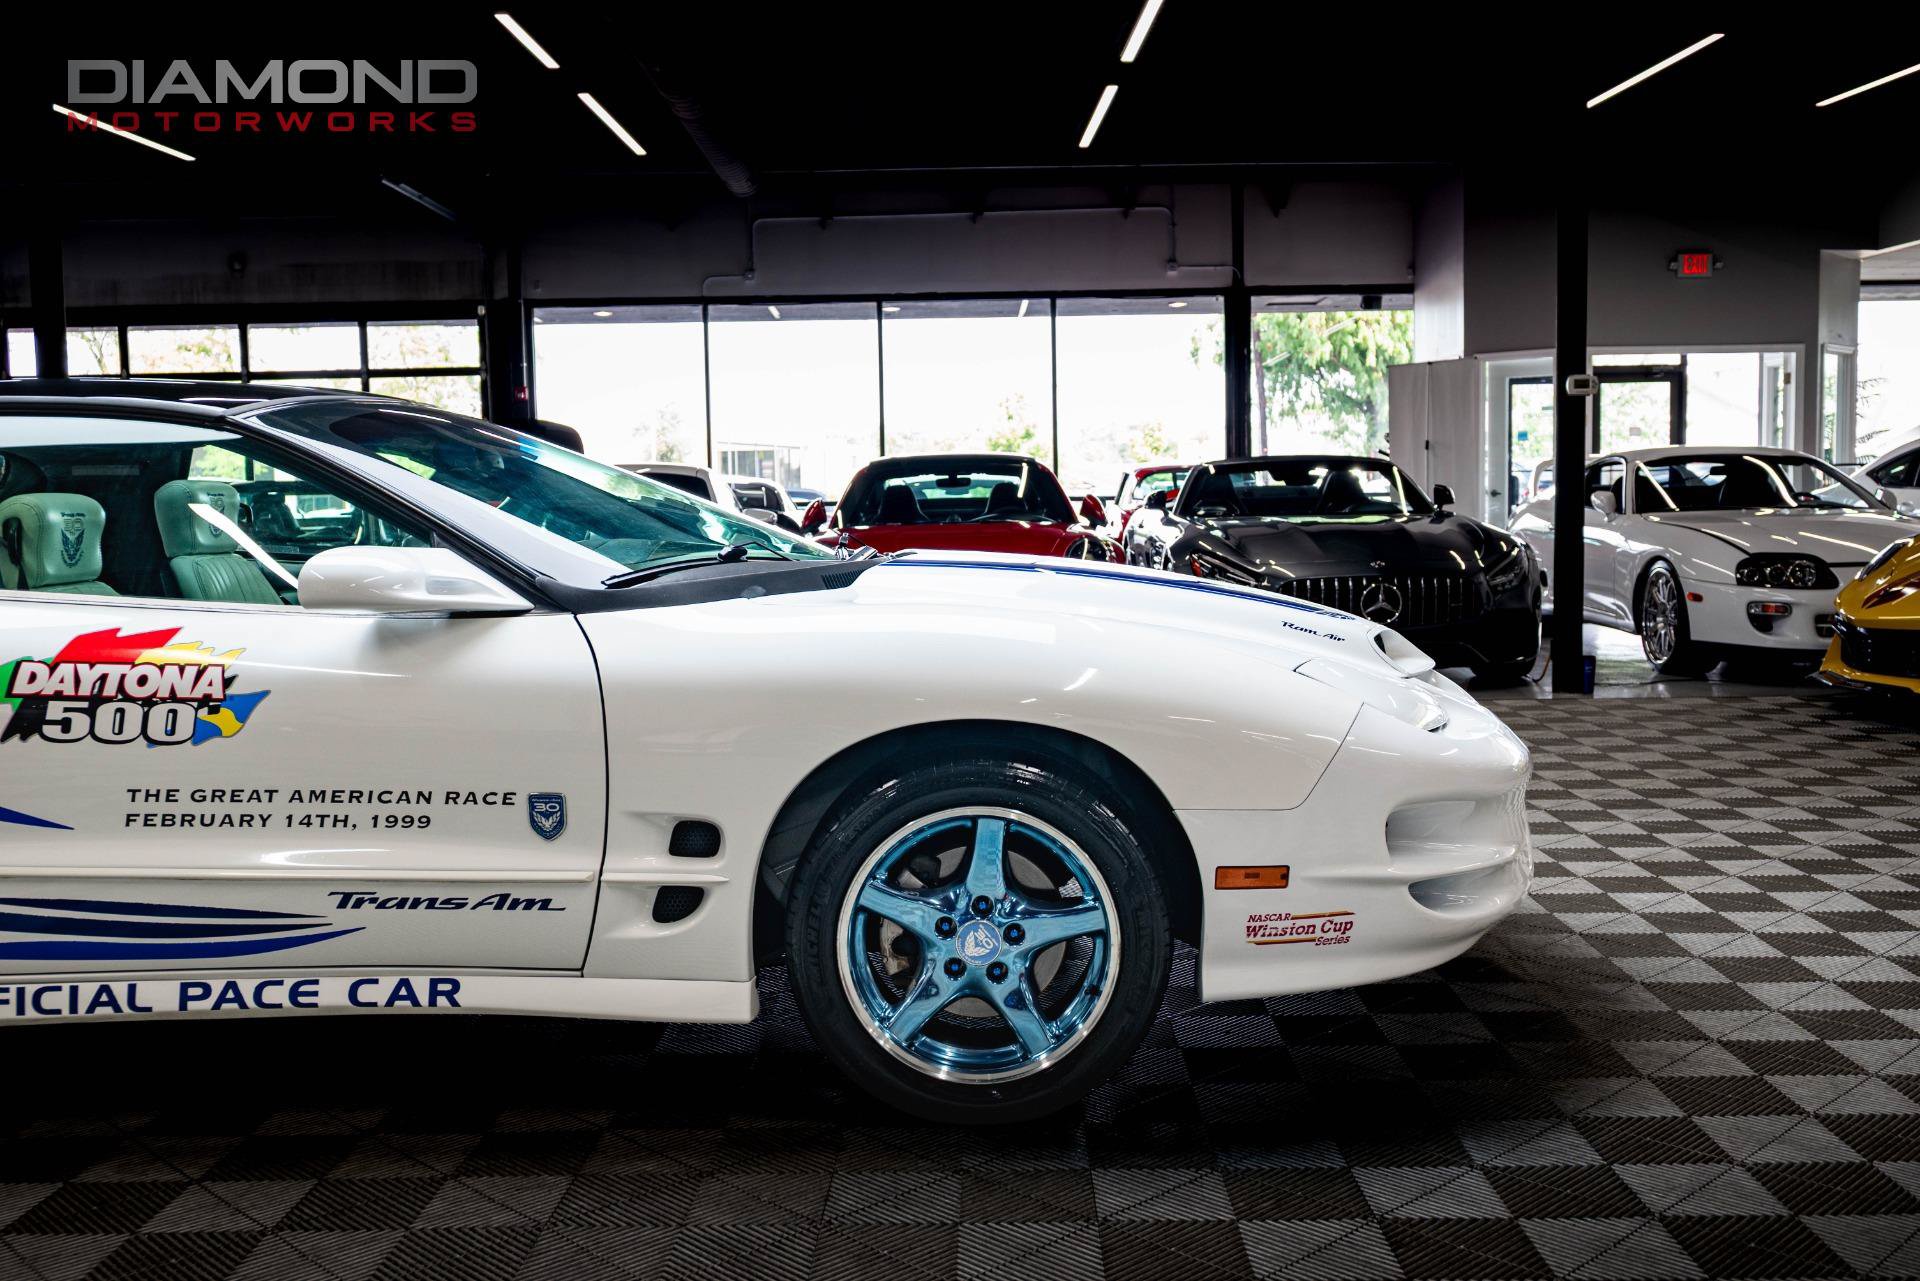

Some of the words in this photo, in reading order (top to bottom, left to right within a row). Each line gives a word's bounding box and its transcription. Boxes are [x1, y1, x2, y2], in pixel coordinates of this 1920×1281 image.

[1281, 620, 1321, 637] Ram
[1322, 633, 1346, 642] Air
[10, 660, 227, 700] DAYTONA
[40, 699, 197, 744] 500
[126, 788, 180, 803] THE
[190, 788, 279, 804] GREAT
[288, 789, 433, 805] AMERICAN
[444, 791, 517, 806] RACE
[533, 802, 560, 812] 30
[125, 813, 273, 829] FEBRUARY
[285, 813, 358, 831] 14TH,
[371, 814, 432, 830] 1999
[327, 891, 469, 910] Trans
[470, 893, 566, 911] Am
[1247, 912, 1292, 923] NASCAR
[1320, 919, 1354, 935] Cup
[1315, 934, 1351, 946] Series
[178, 978, 320, 1012] PACE
[347, 977, 463, 1009] CAR
